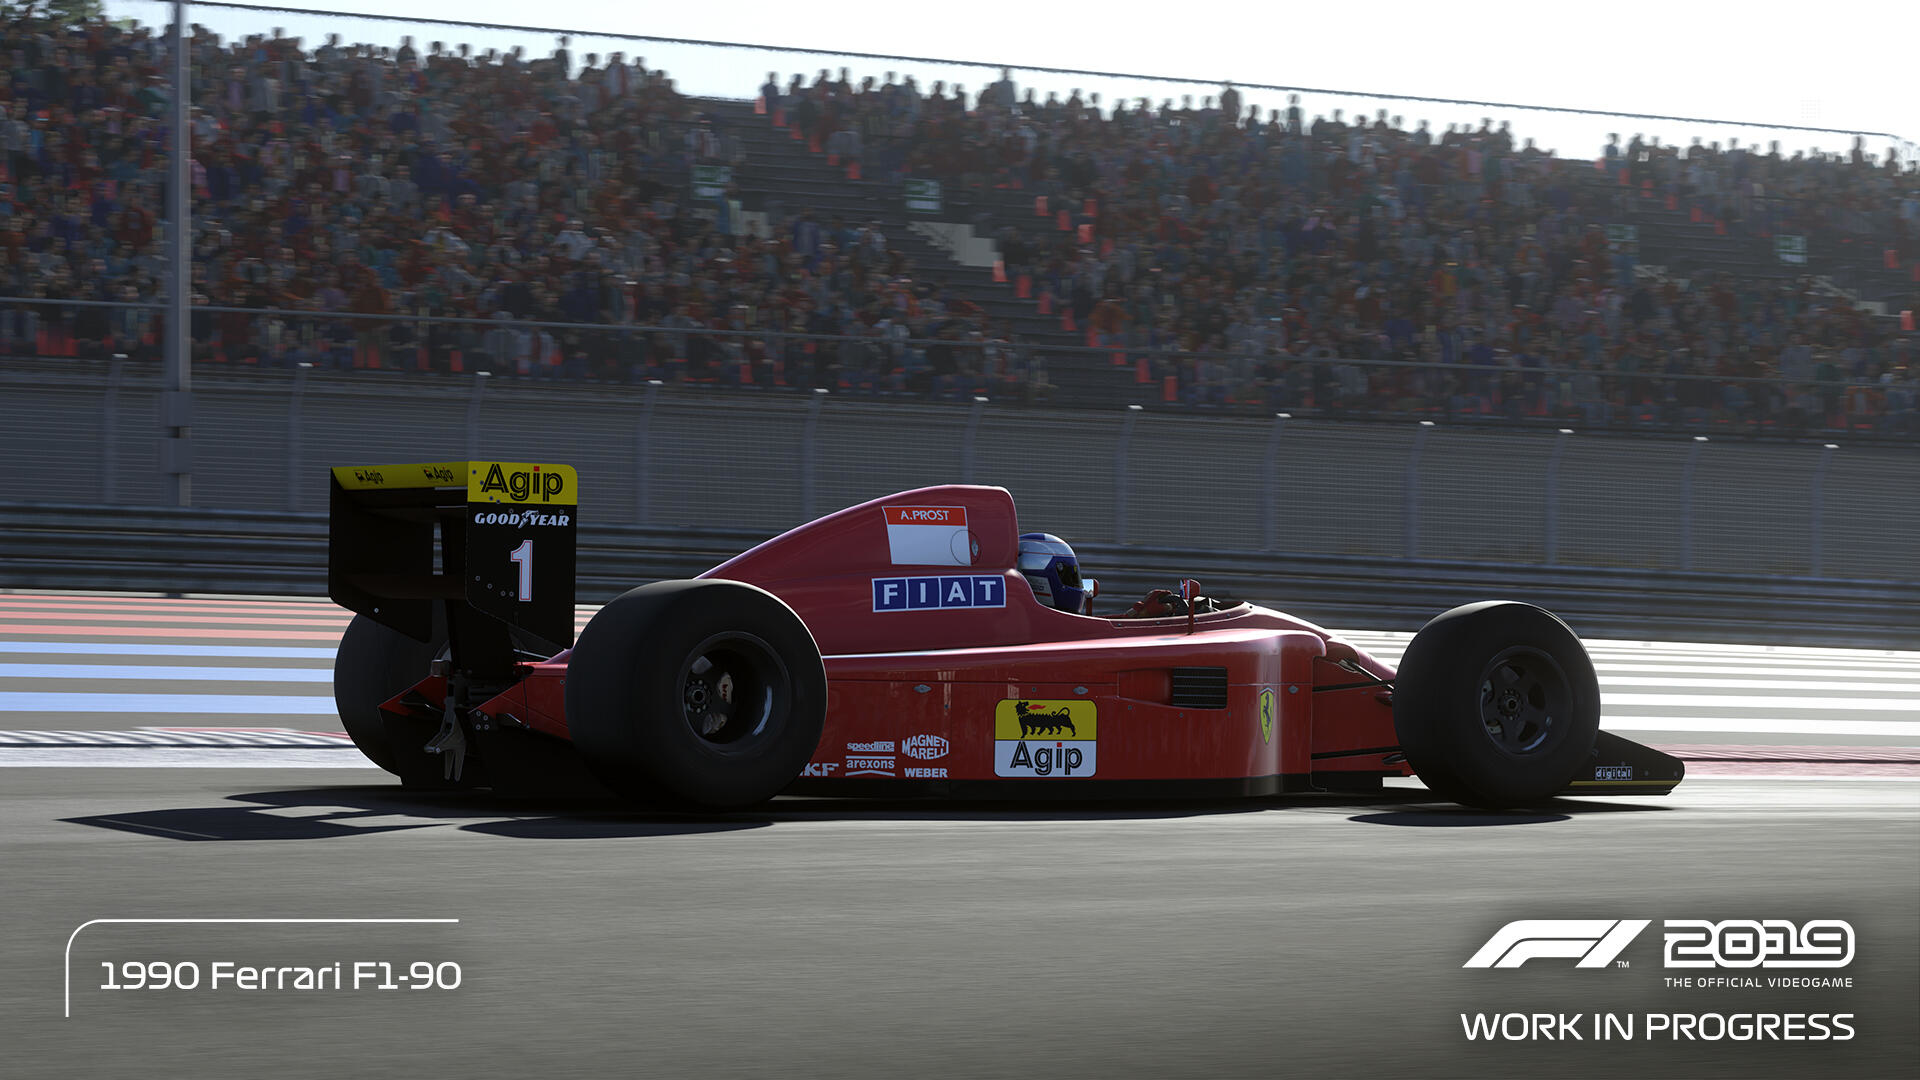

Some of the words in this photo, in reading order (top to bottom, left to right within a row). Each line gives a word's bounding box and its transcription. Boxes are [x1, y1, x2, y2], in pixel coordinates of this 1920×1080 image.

[365, 470, 384, 485] Agip
[434, 466, 454, 482] Agip
[481, 464, 563, 502] Agip
[901, 510, 949, 521] A.PROST
[511, 540, 533, 601] 1
[883, 580, 997, 605] FIAT
[847, 742, 895, 752] speedline
[846, 760, 895, 769] arexons
[1010, 741, 1083, 776] Agip
[800, 763, 839, 777] KF
[904, 768, 948, 778] WEBER
[1596, 767, 1631, 778] digital
